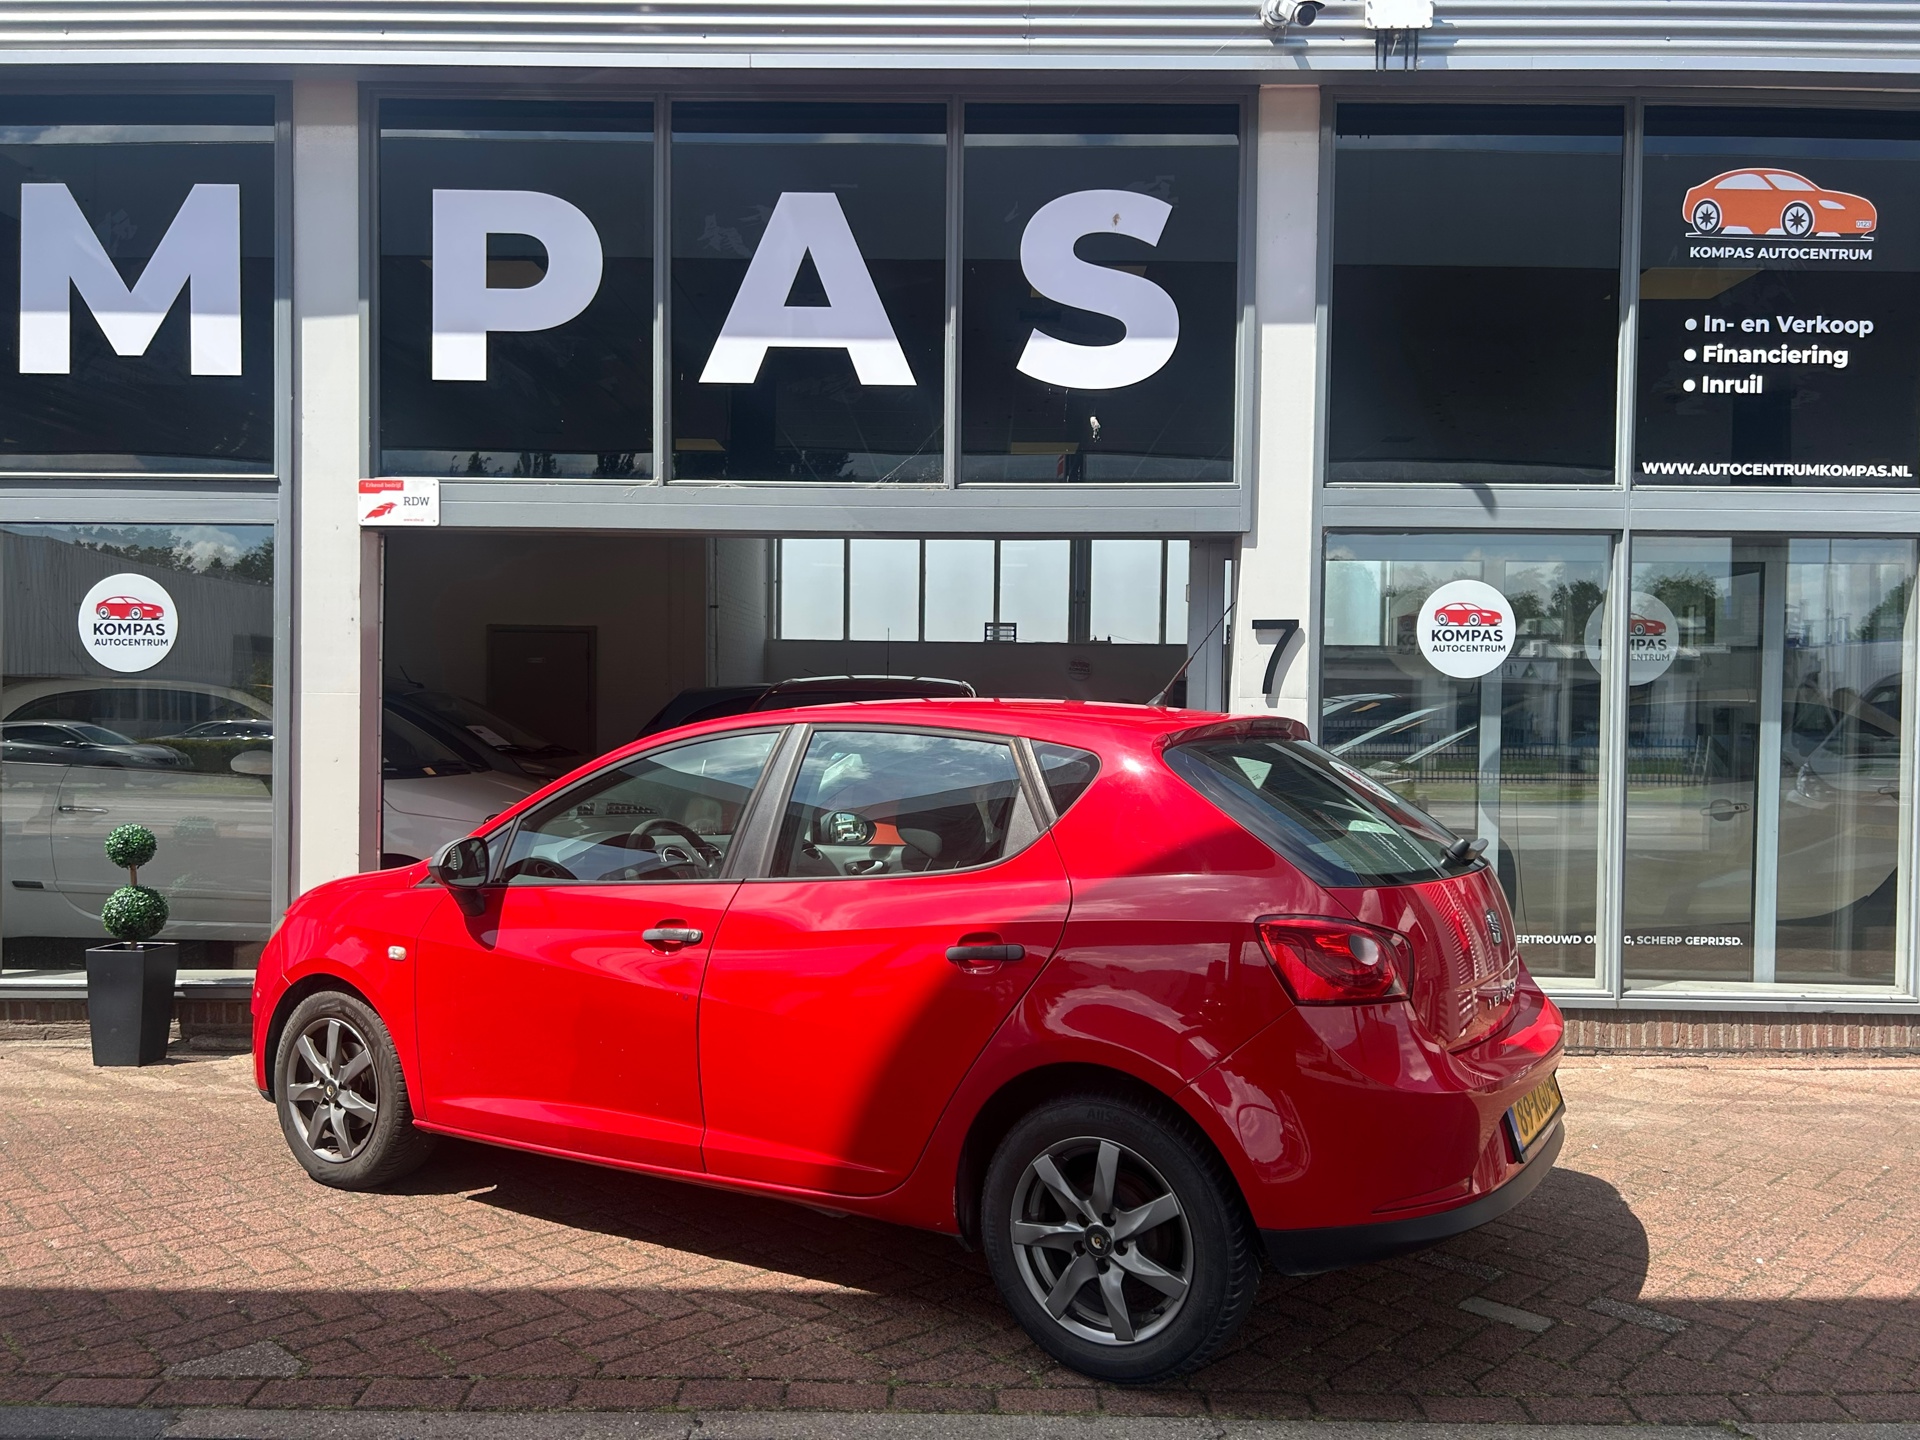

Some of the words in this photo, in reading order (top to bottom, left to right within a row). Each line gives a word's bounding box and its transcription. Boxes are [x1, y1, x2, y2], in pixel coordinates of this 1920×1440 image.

[1690, 246, 1754, 259] KOMPAS
[1757, 248, 1872, 260] AUTOCENTRUM
[1704, 315, 1734, 332] In-
[1741, 319, 1770, 332] en
[1776, 316, 1874, 338] Verkoop
[1703, 344, 1849, 368] Financiering
[1702, 374, 1763, 394] Inruil
[1642, 462, 1913, 478] WWW.AUTOCENTRUMKOMPAS.NL
[403, 496, 430, 506] RDW
[93, 623, 166, 636] KOMPAS
[1431, 629, 1503, 642] KOMPAS
[94, 638, 169, 647] AUTOCENTRUM
[1432, 644, 1506, 652] AUTOCENTRUM
[1252, 620, 1300, 695] 7
[1516, 934, 1582, 945] ERTROUWD
[1636, 935, 1682, 946] SCHERP
[1685, 936, 1744, 947] GEPRIJSD.
